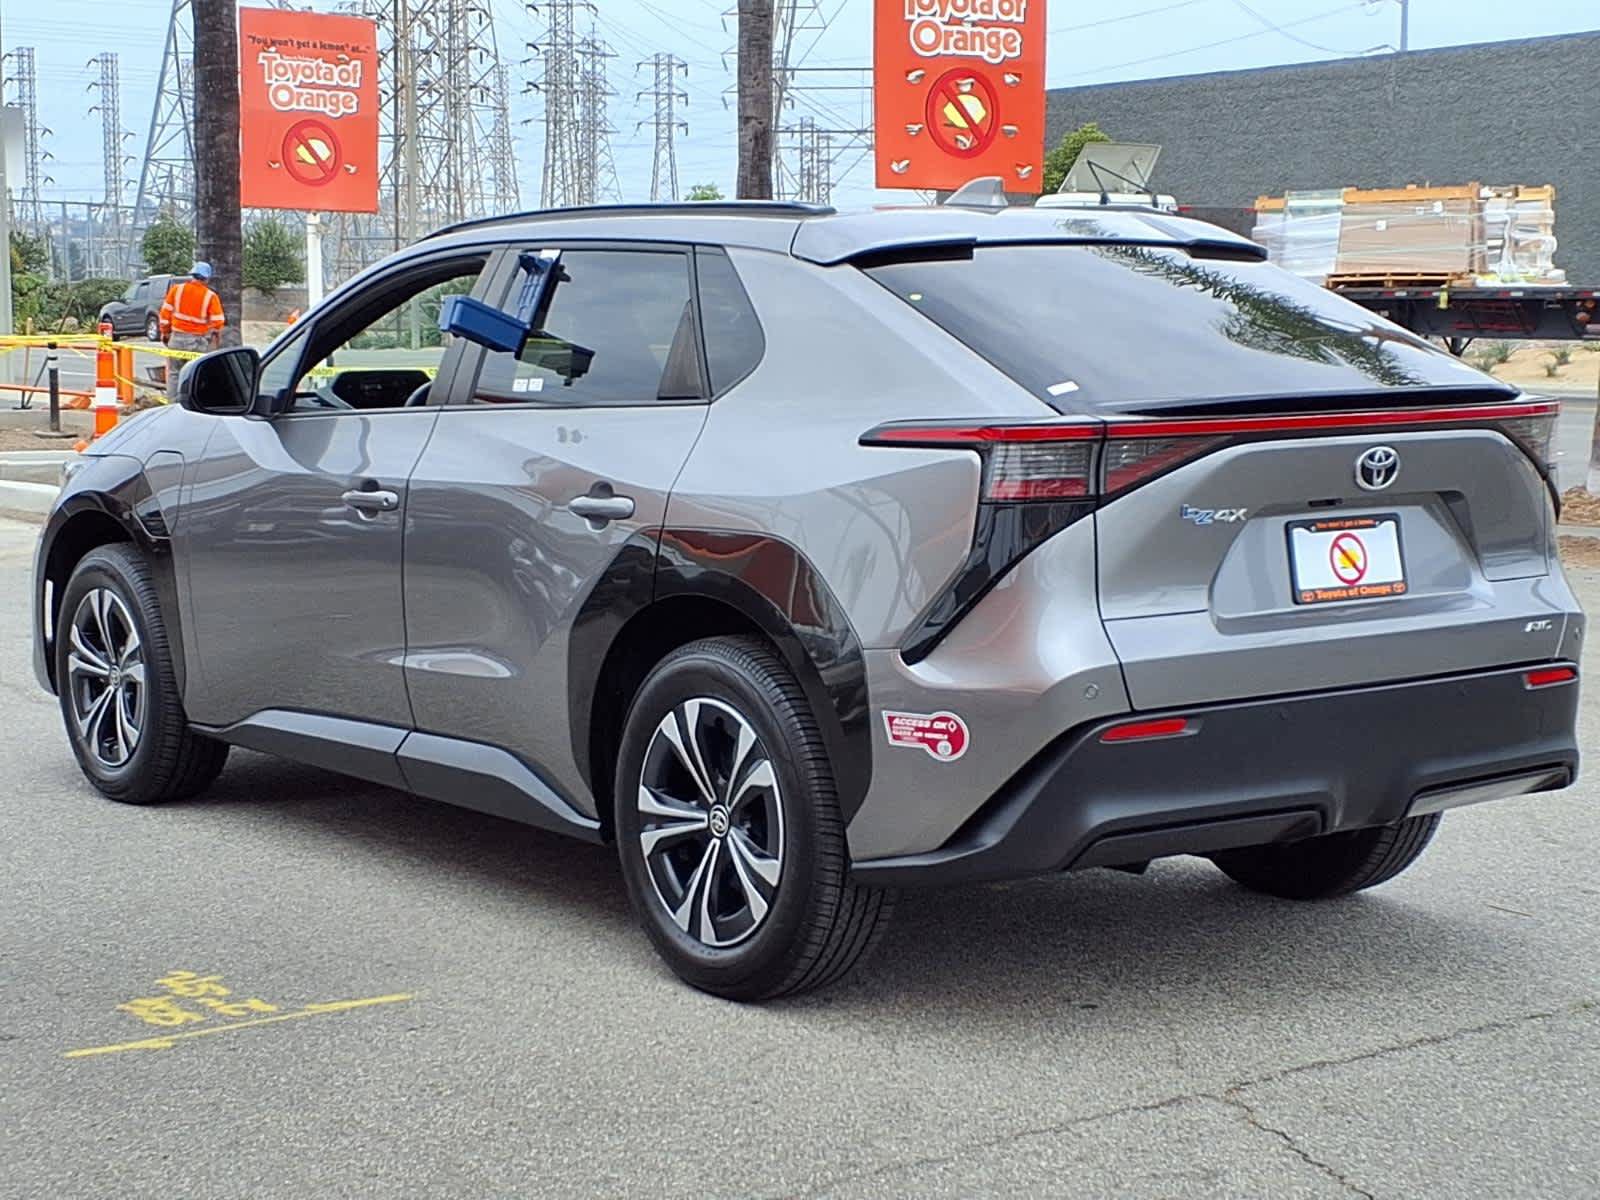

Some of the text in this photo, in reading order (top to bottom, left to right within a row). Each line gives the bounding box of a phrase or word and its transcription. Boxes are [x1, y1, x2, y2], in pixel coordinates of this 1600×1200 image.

[911, 17, 1021, 62] Orange
[259, 54, 361, 86] Toyota of
[270, 84, 357, 116] Orange
[1315, 585, 1392, 600] Toyota of Orange
